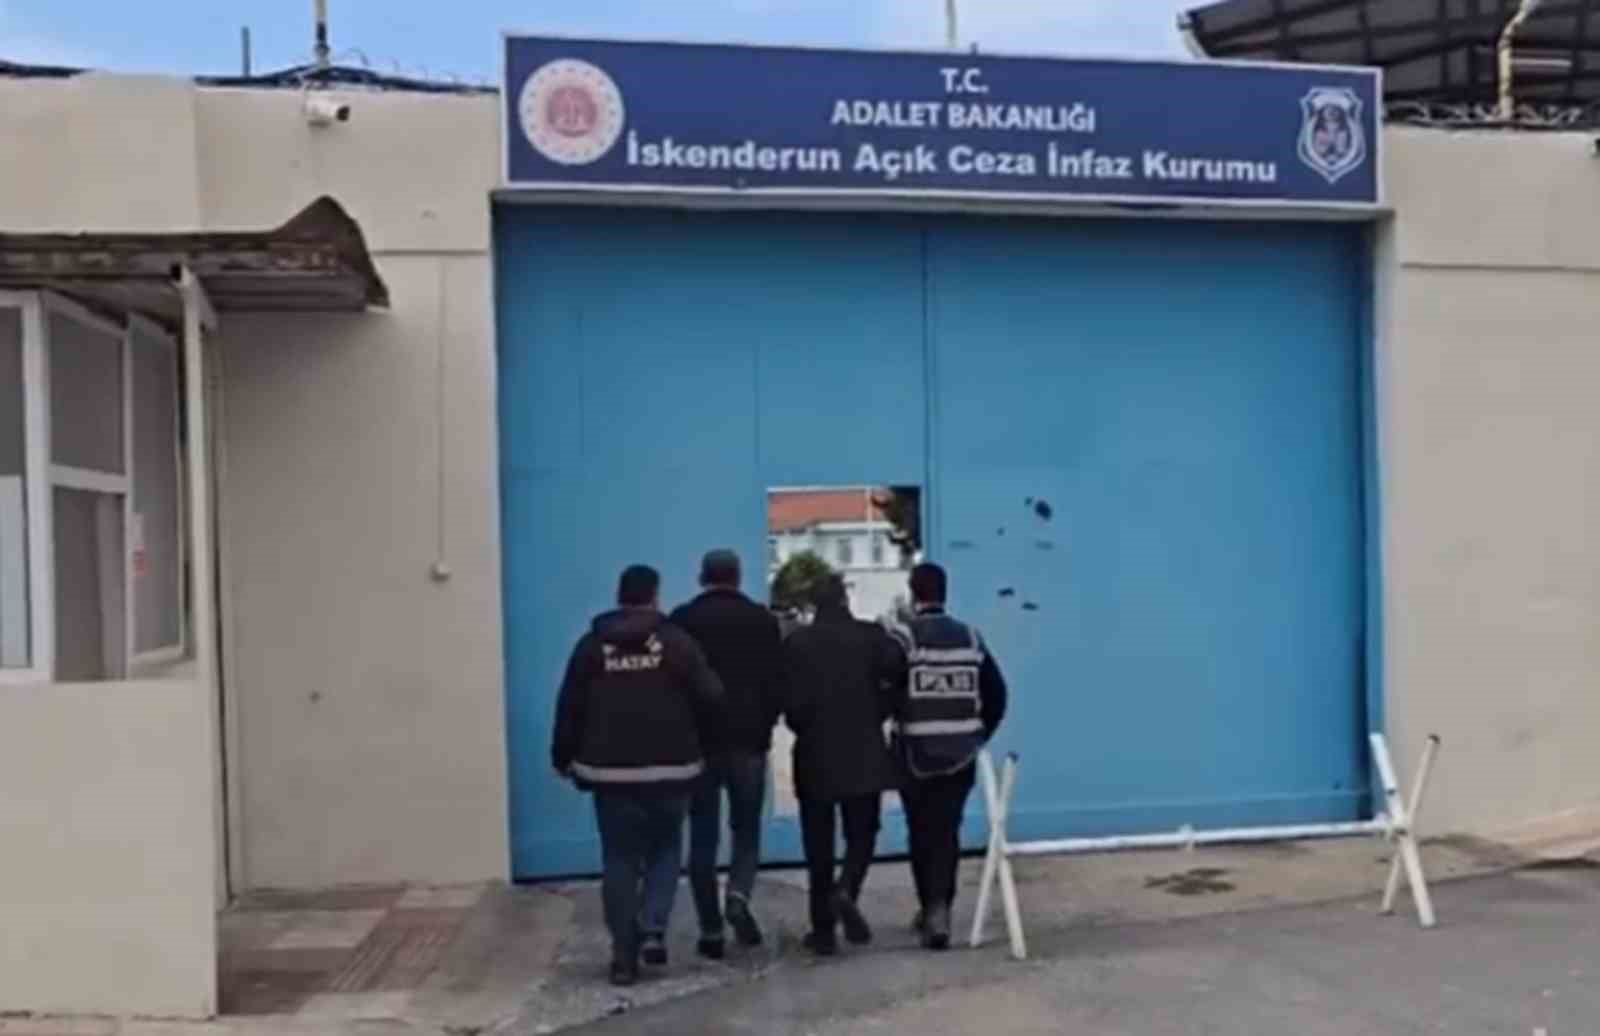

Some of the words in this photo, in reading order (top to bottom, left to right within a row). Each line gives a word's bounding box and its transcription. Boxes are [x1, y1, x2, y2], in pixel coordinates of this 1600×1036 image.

[941, 68, 988, 93] T.C.
[831, 100, 942, 126] ADALET
[948, 102, 1095, 133] BAKANLIĞI
[626, 130, 840, 171] İskenderun
[854, 144, 937, 179] Açık
[948, 146, 1036, 175] Ceza
[1048, 141, 1132, 178] İnfaz
[1143, 152, 1277, 182] Kurumu
